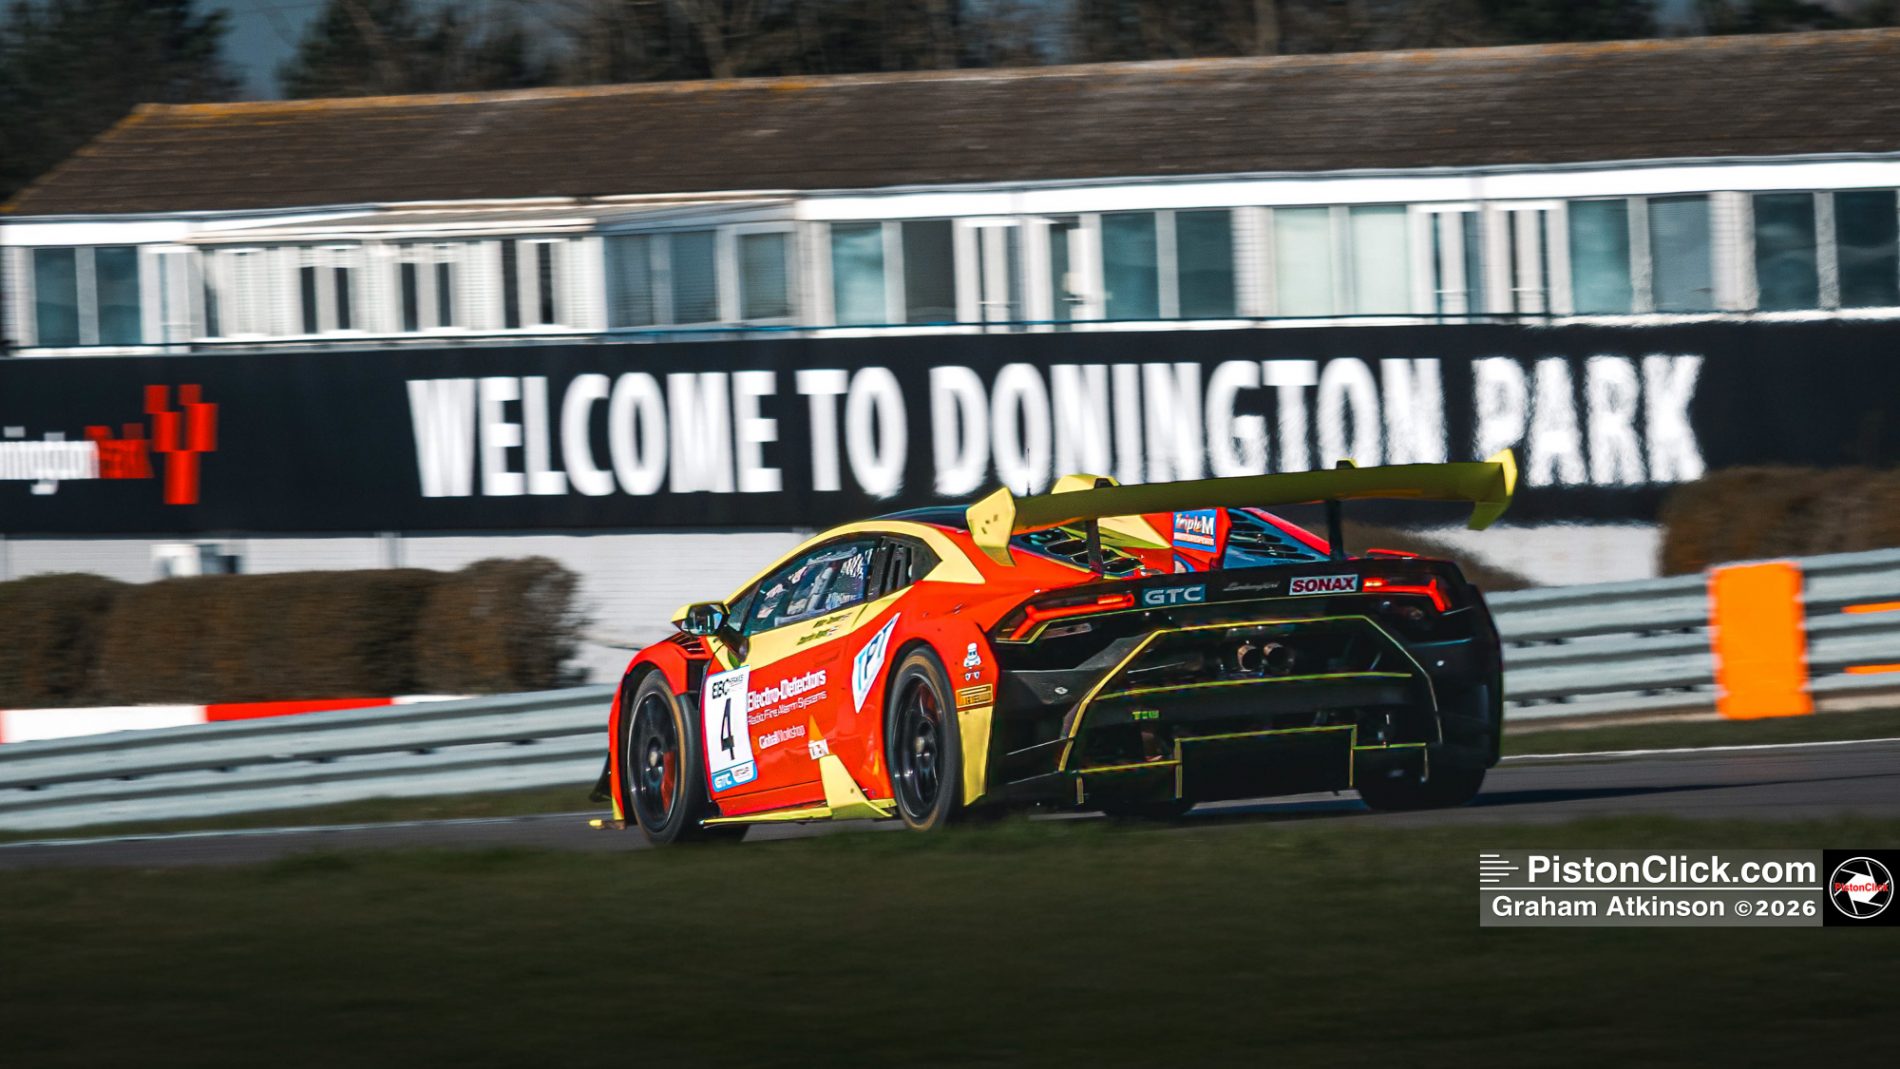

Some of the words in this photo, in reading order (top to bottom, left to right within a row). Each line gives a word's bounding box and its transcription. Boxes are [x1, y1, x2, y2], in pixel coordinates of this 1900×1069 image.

[407, 371, 783, 497] WELCOME
[795, 366, 906, 498] TO
[929, 356, 1447, 498] DONINGTON
[1471, 352, 1706, 487] PARK
[1292, 577, 1355, 593] SONAX
[1145, 587, 1202, 605] GTC
[712, 679, 730, 699] EBC
[747, 669, 826, 713] Electro-Detectors
[798, 690, 827, 709] Systems
[720, 697, 736, 761] 4
[714, 773, 733, 789] GTC
